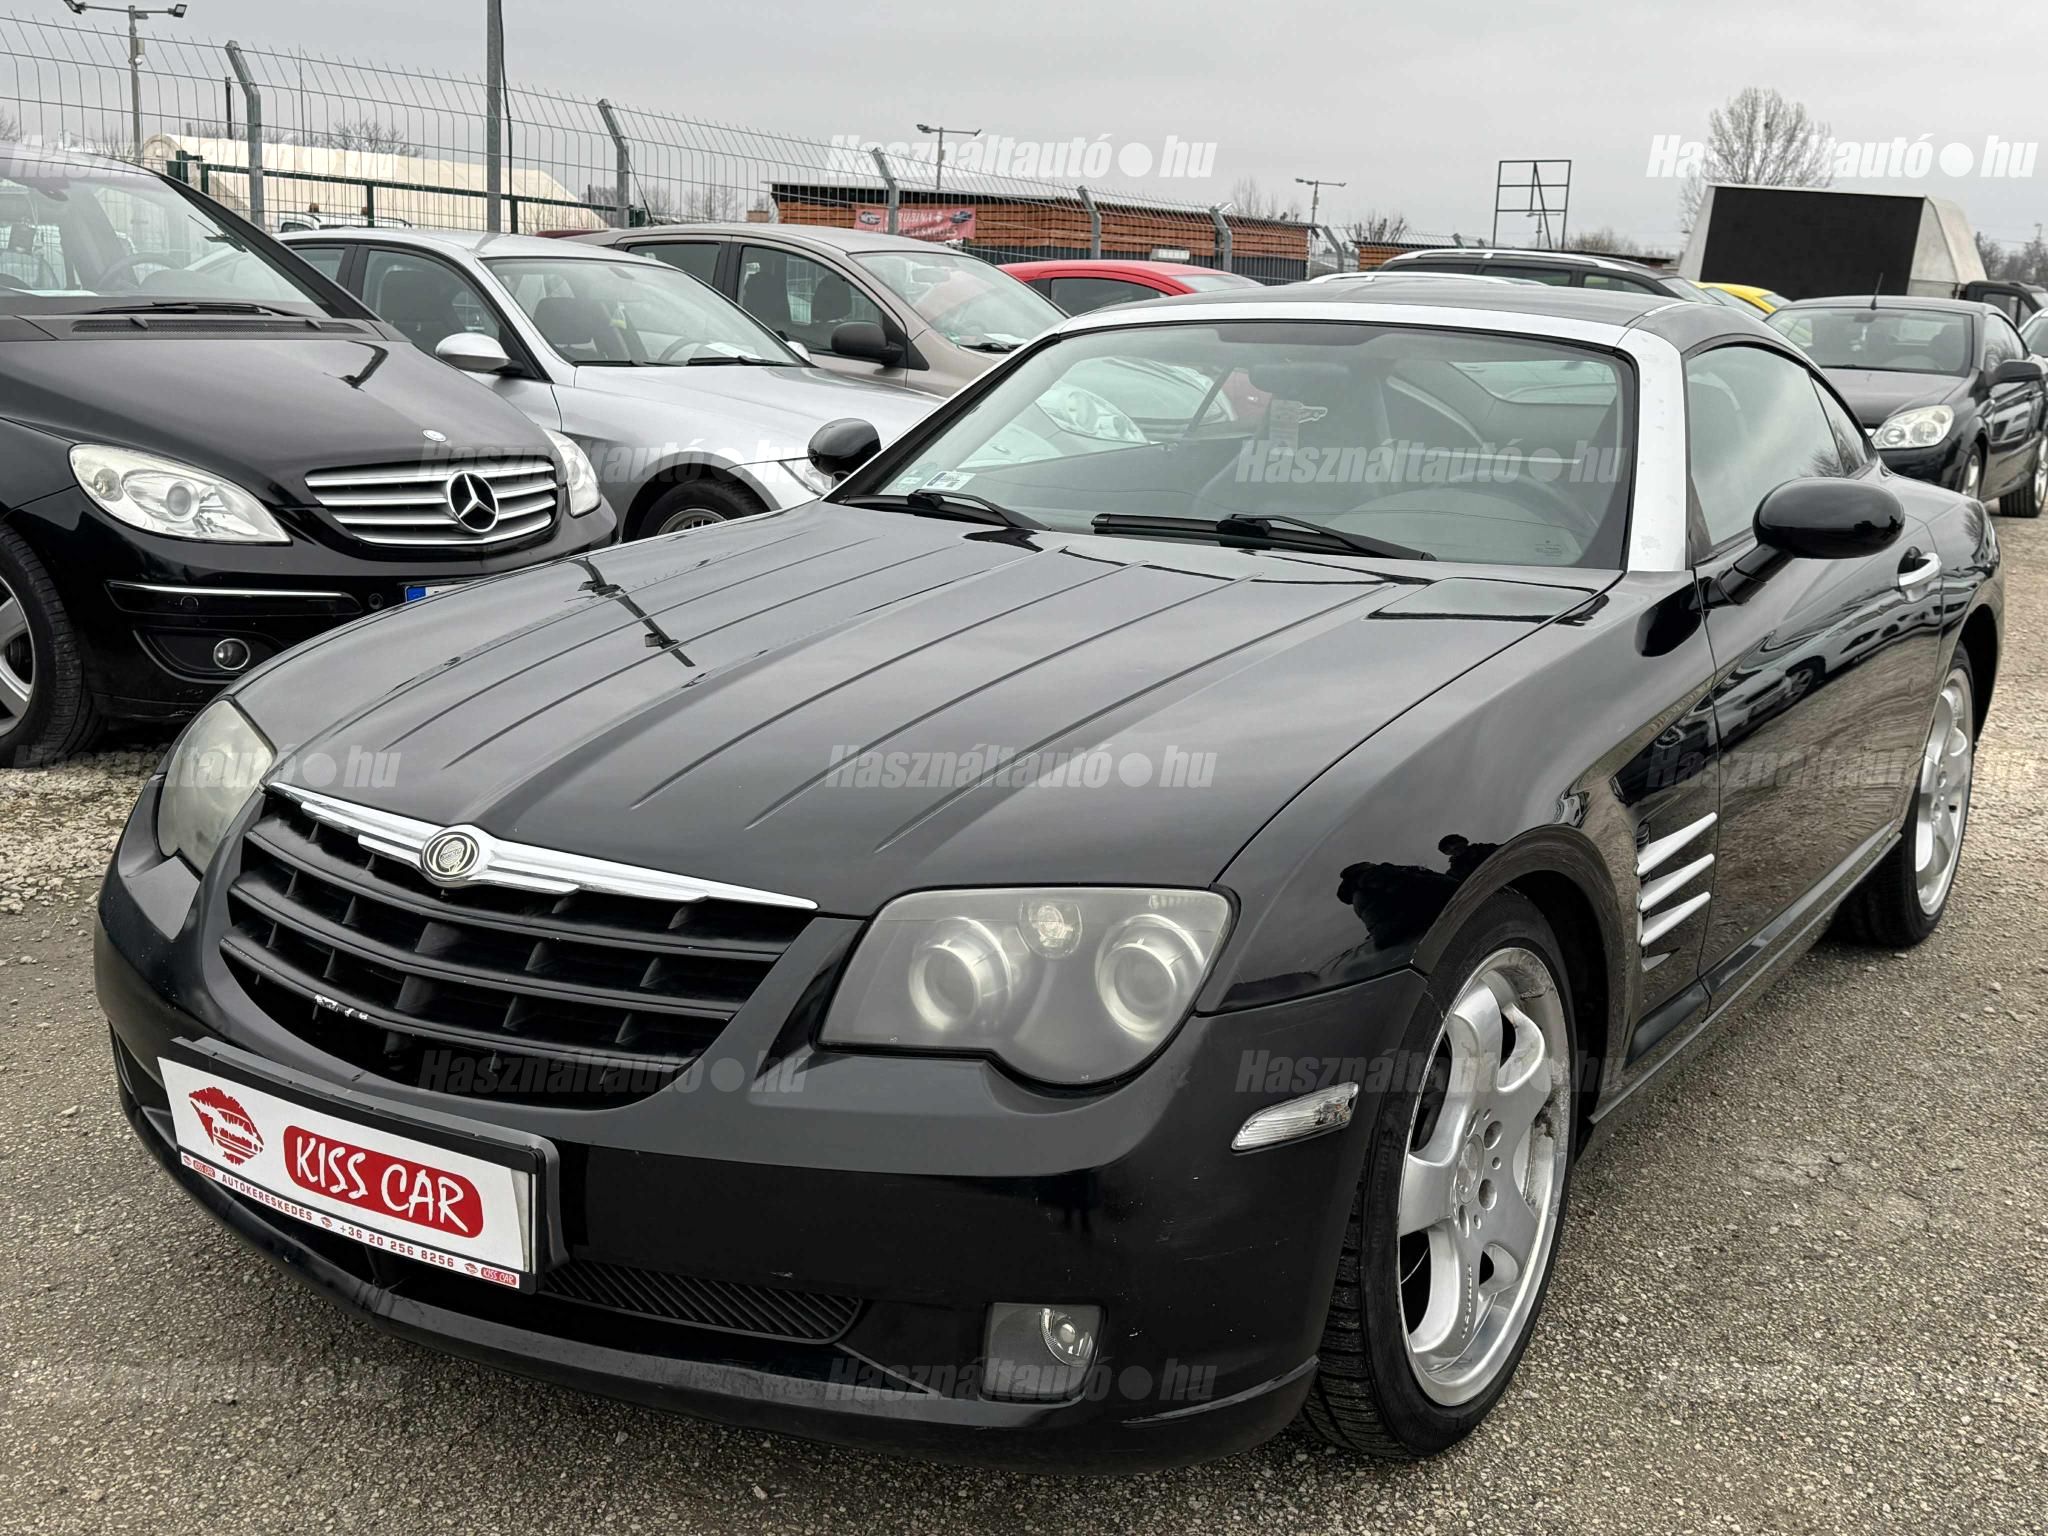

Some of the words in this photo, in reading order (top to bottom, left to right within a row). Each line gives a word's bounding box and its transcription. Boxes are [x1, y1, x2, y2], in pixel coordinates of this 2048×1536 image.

[296, 1135, 368, 1200] KISS
[380, 1163, 469, 1233] CAR
[340, 1224, 363, 1240] +36
[368, 1233, 384, 1246] 20
[390, 1240, 414, 1256] 256
[420, 1248, 454, 1268] 8256
[499, 1272, 515, 1284] CAR
